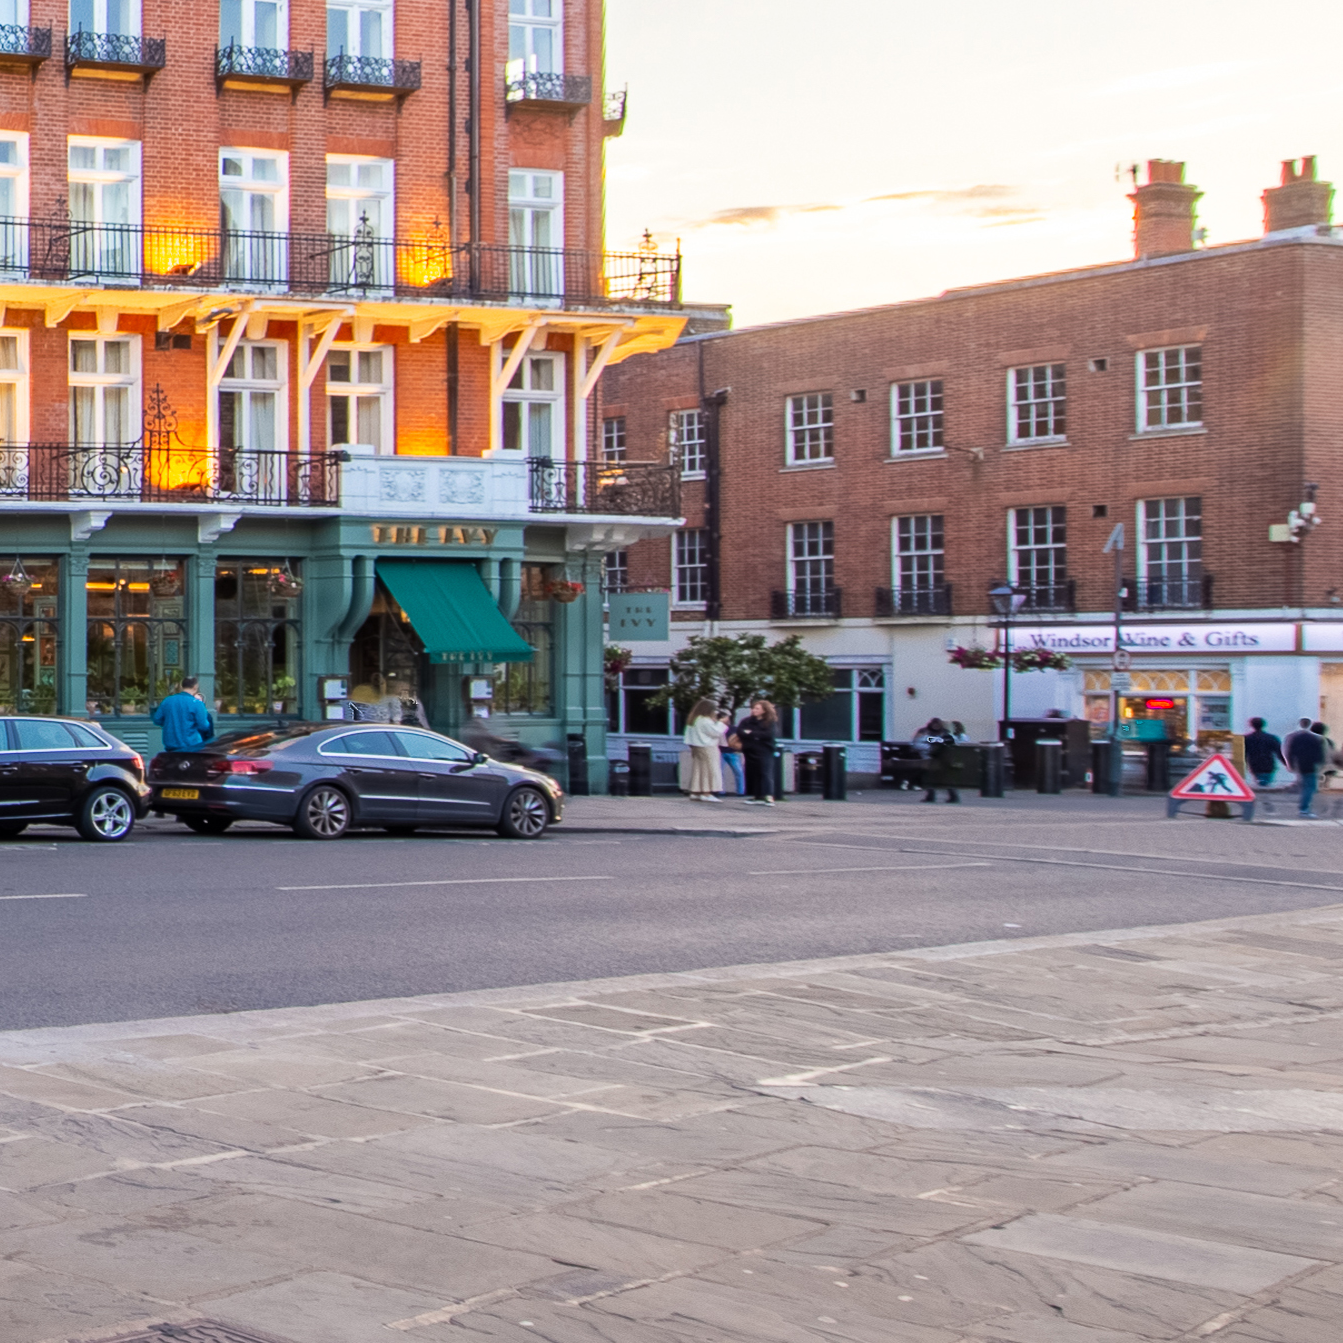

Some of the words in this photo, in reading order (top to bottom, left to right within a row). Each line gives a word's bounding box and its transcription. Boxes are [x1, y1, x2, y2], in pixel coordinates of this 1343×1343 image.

[371, 523, 426, 545] THE
[438, 524, 499, 545] IVY
[626, 606, 652, 614] THE
[620, 618, 656, 627] IVY
[1030, 633, 1111, 647] Windsor
[1178, 633, 1195, 647] &
[1205, 630, 1259, 647] Gifts
